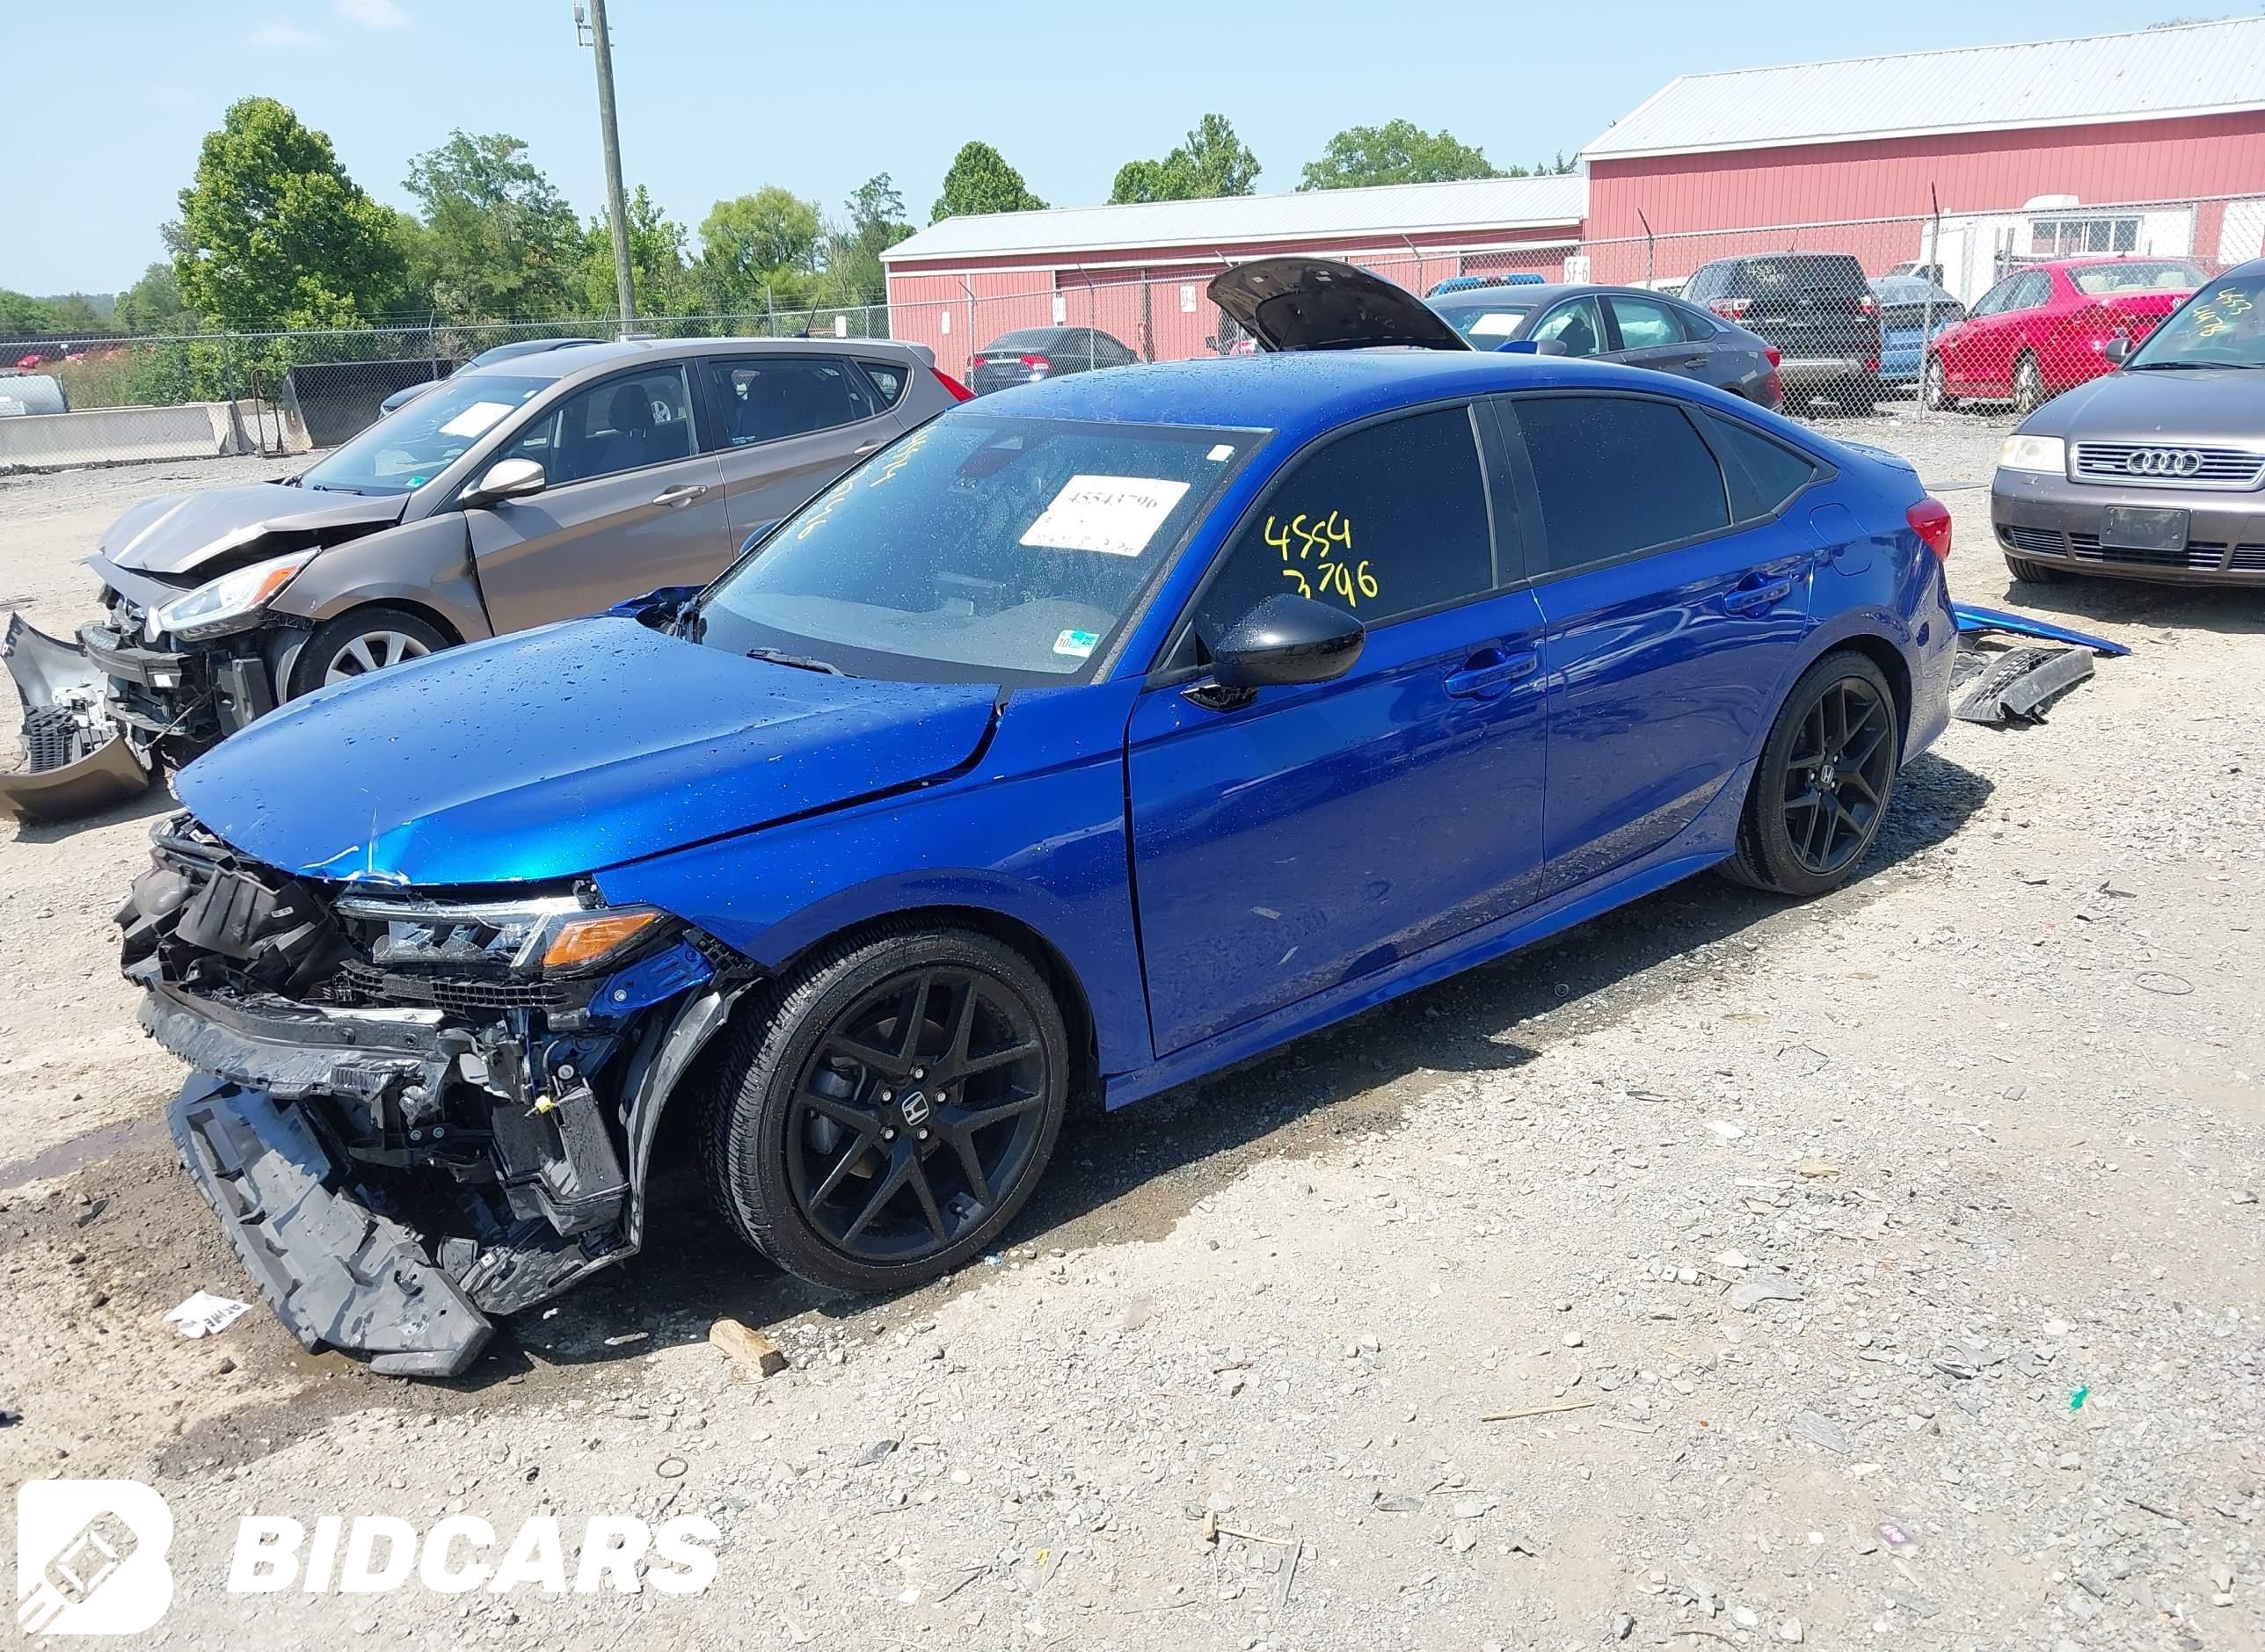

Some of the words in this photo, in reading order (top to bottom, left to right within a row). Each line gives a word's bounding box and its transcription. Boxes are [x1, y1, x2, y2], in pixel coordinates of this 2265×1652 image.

[1566, 261, 1588, 283] SF-6
[2215, 287, 2253, 316] 4553
[1264, 510, 1351, 561] 4554
[1282, 560, 1379, 608] 3796
